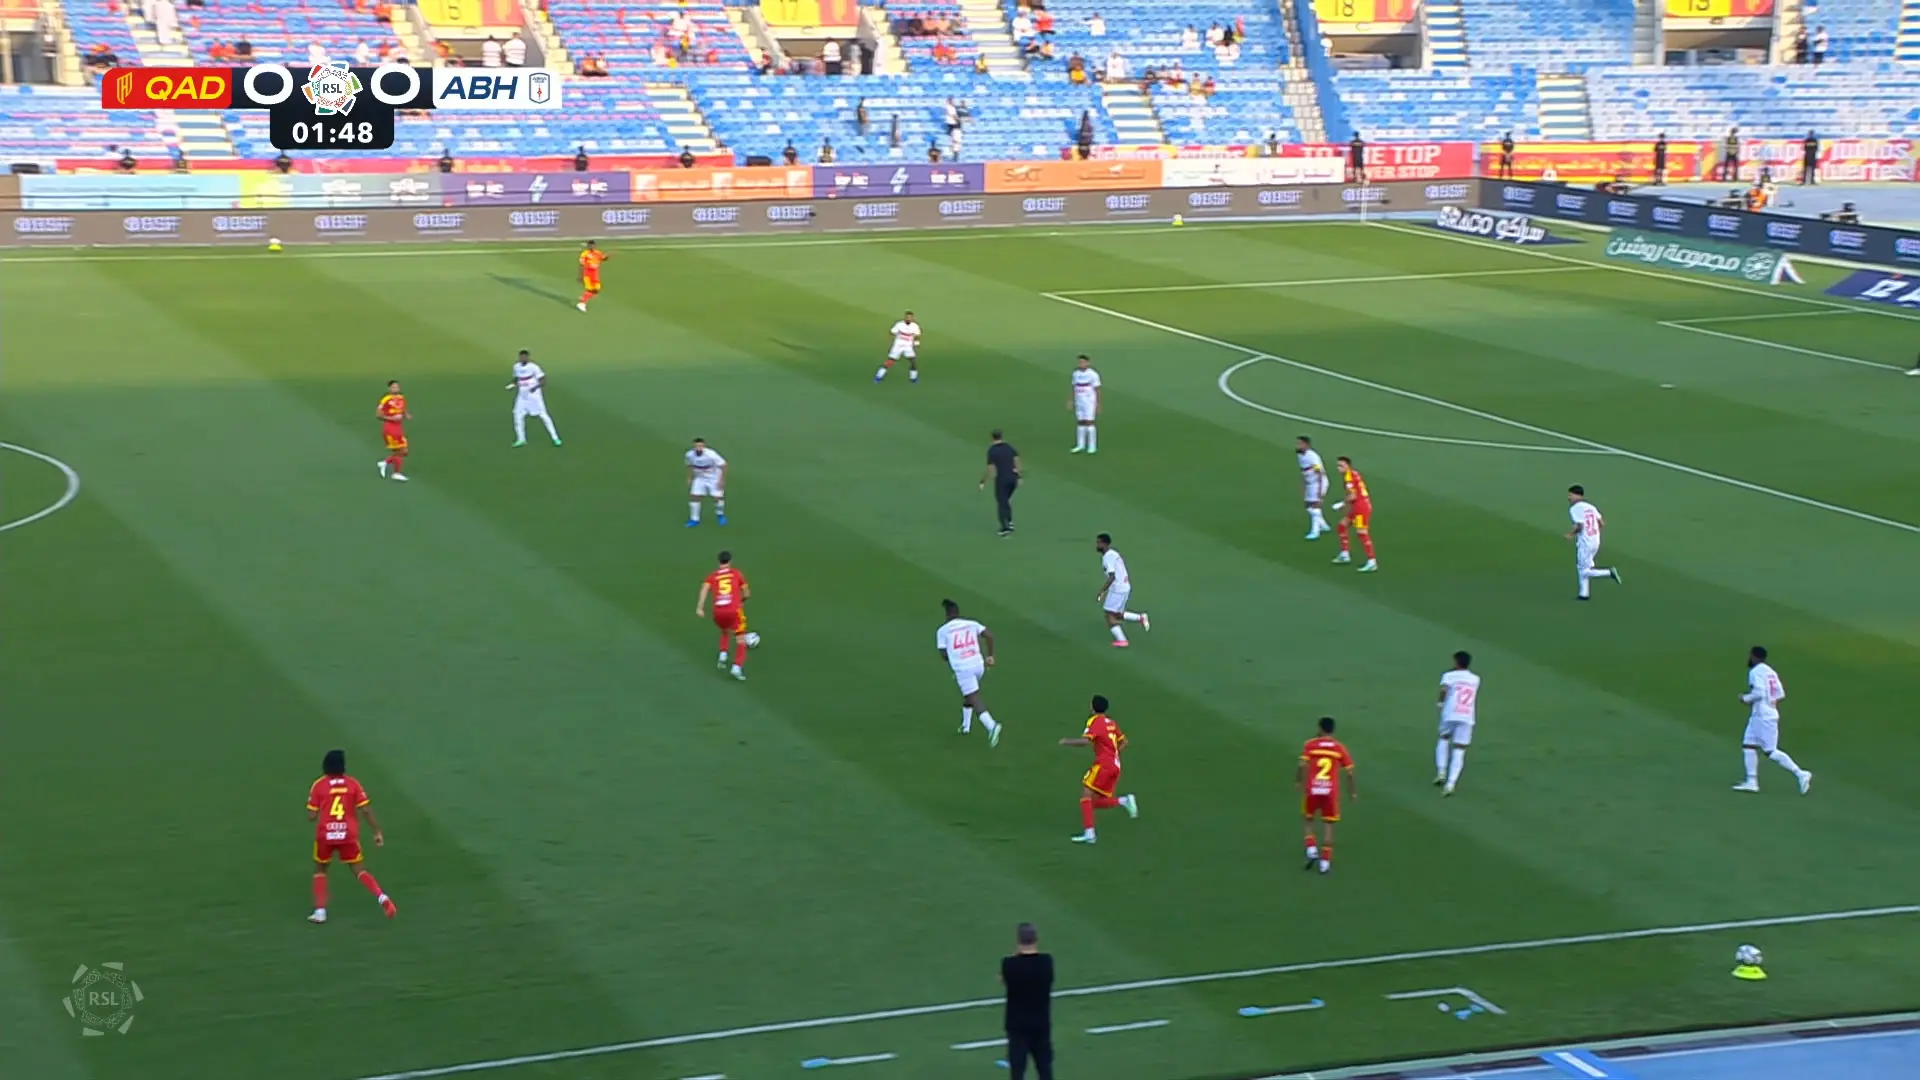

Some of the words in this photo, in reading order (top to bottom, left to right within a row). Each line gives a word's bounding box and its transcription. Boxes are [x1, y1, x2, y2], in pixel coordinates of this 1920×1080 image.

[1391, 145, 1442, 165] TOP
[1003, 167, 1044, 182] SXT
[1397, 164, 1441, 179] STOP
[1605, 235, 1666, 263] روشن
[1662, 243, 1741, 271] مجموعة
[718, 579, 732, 595] 5
[952, 630, 976, 650] 44
[1315, 757, 1333, 780] 2
[329, 794, 345, 820] 4
